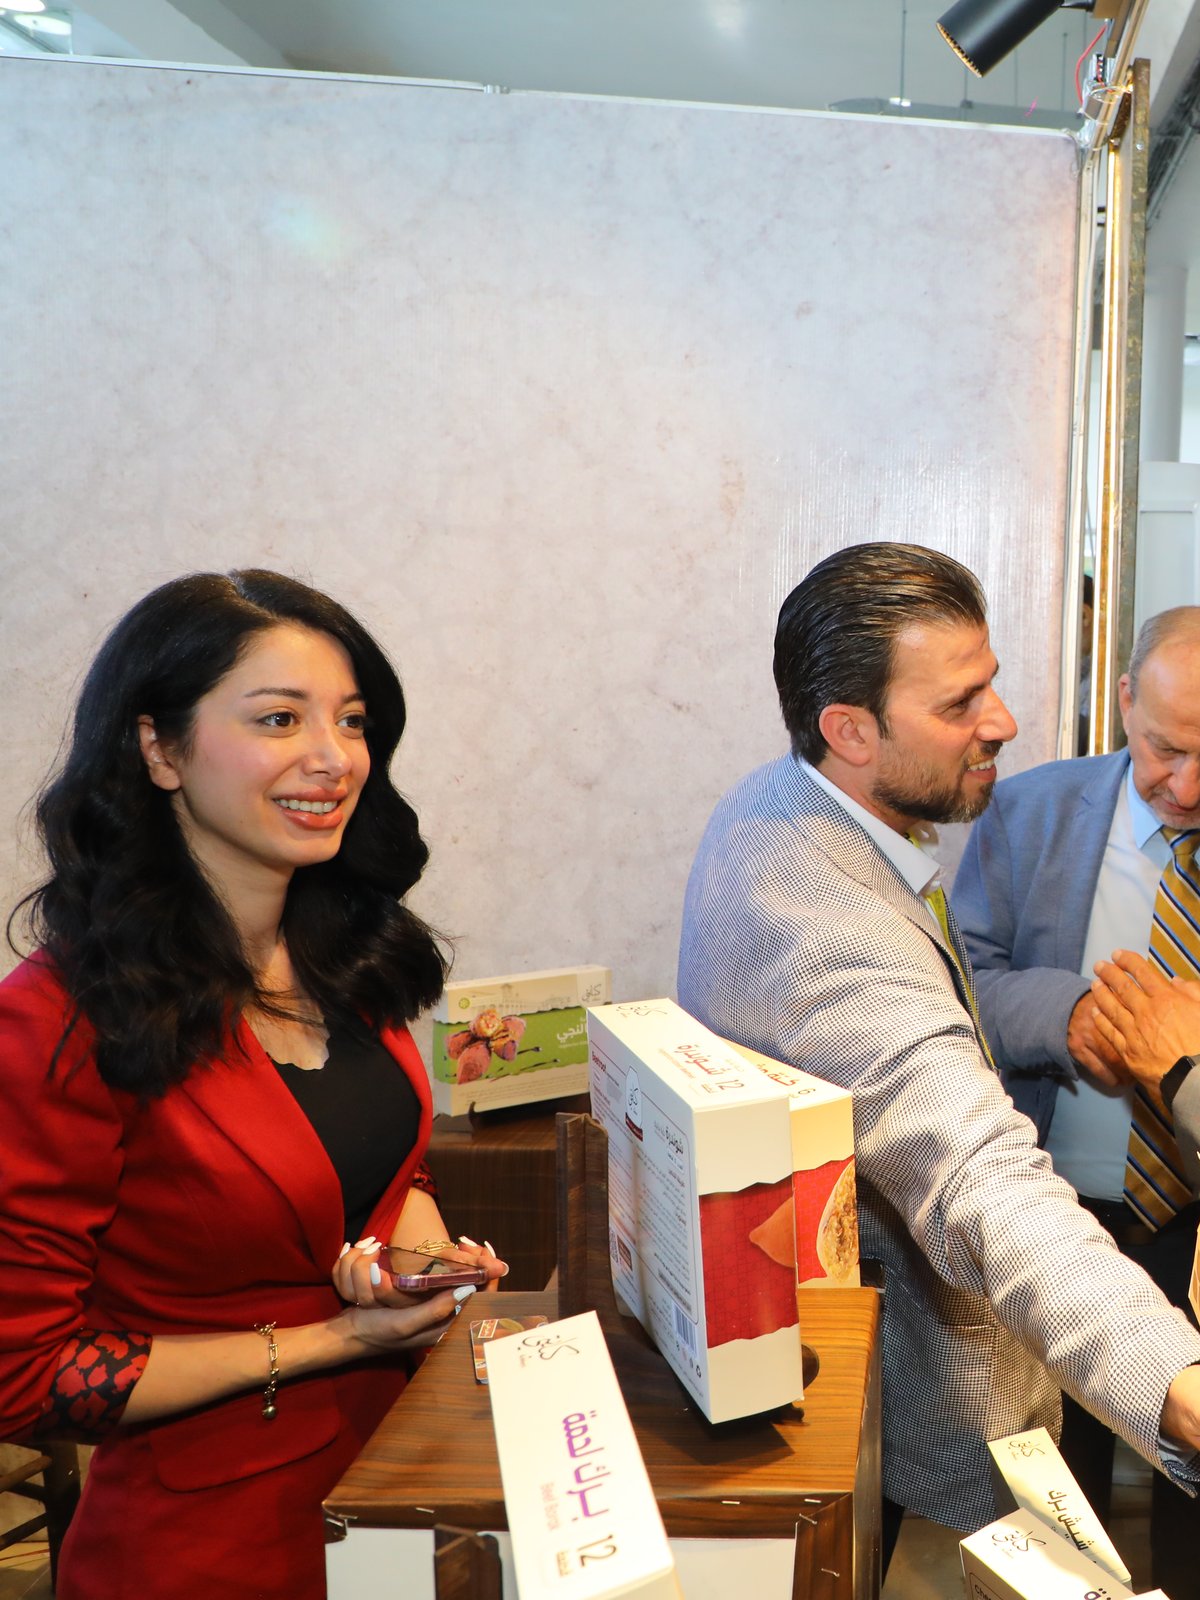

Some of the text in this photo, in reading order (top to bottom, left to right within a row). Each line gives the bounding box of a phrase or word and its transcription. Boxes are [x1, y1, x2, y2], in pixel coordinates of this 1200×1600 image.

[716, 1079, 744, 1091] 12
[563, 1409, 617, 1567] 12 برك لحمة
[1047, 1490, 1094, 1551] شيش برك
